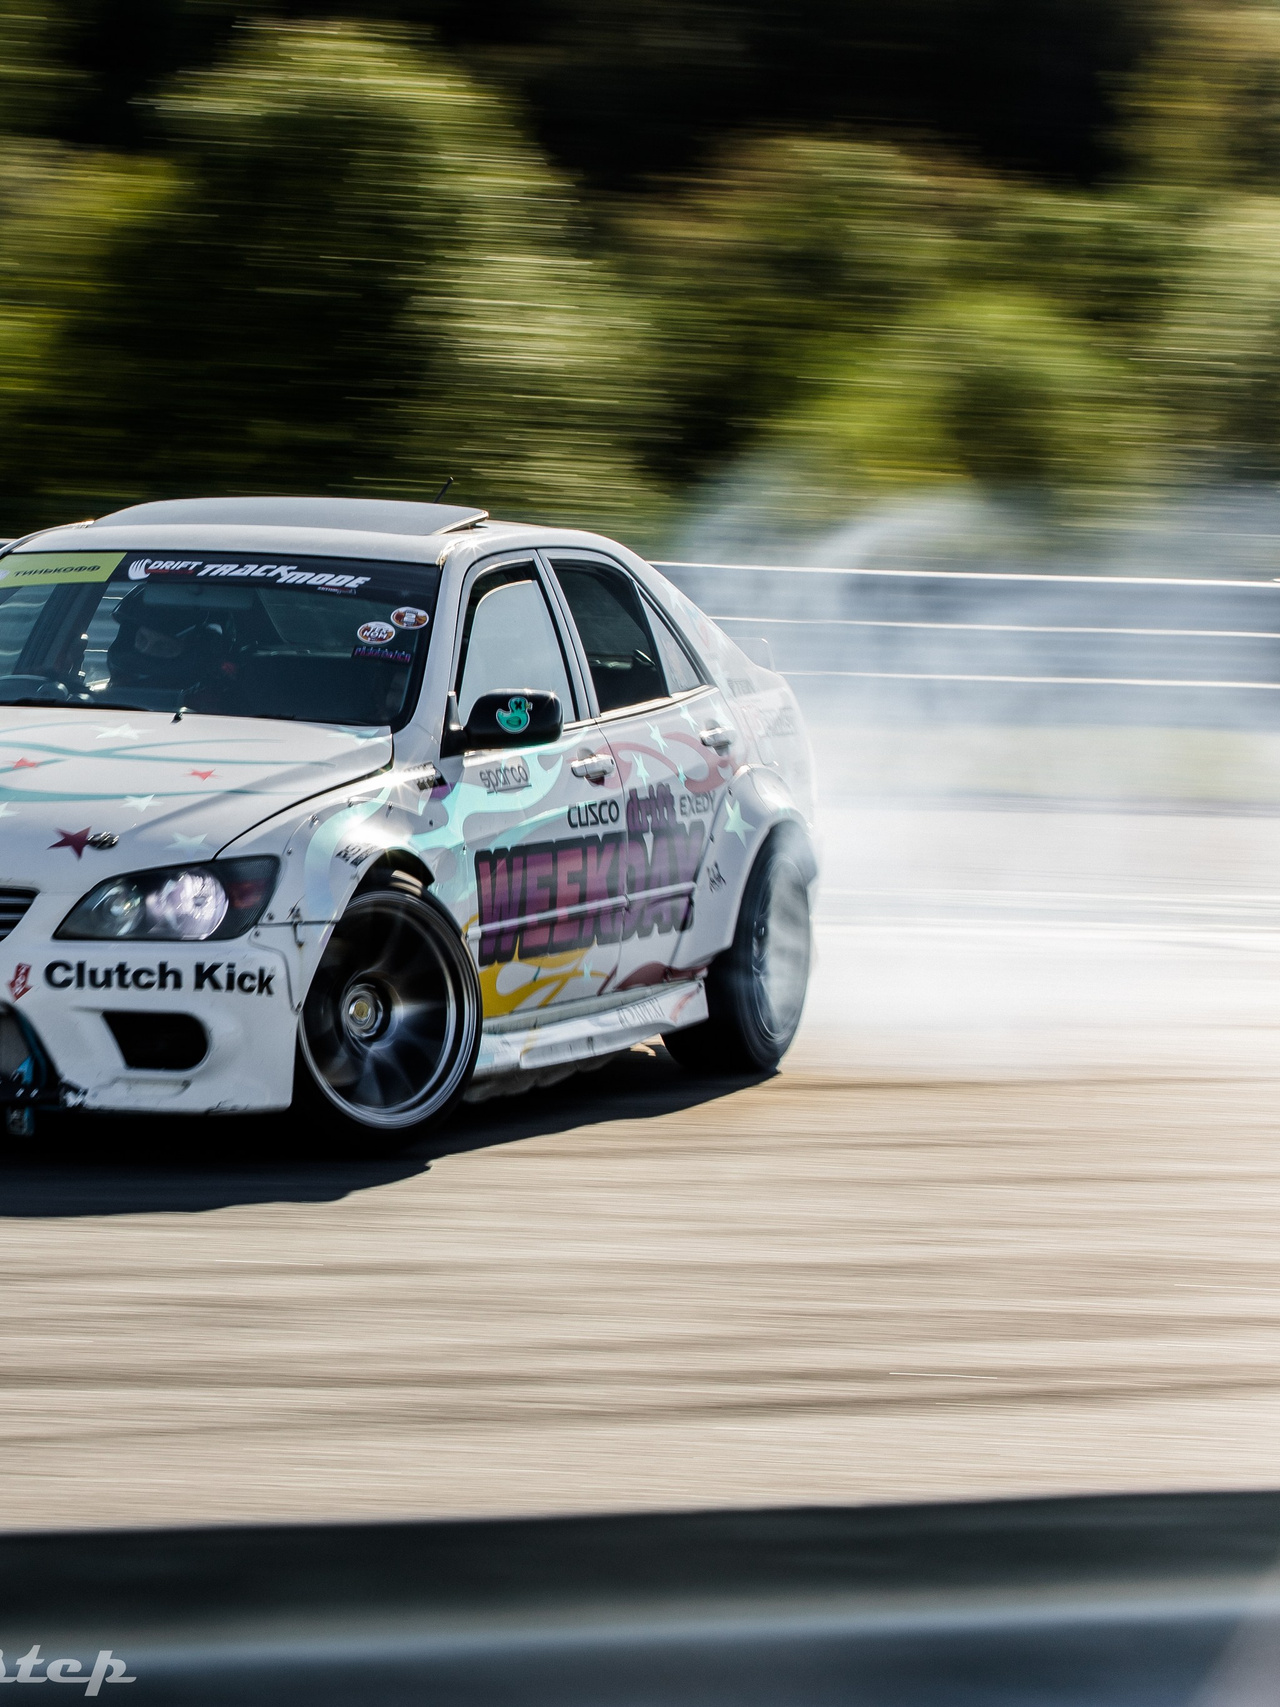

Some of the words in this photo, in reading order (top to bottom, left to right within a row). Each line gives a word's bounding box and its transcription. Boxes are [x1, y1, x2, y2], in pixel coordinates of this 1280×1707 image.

[148, 560, 204, 571] DRIFT
[479, 765, 529, 793] sparco
[475, 822, 705, 966] WEEKDAY
[43, 960, 182, 991] Clutch
[193, 962, 276, 997] Kick
